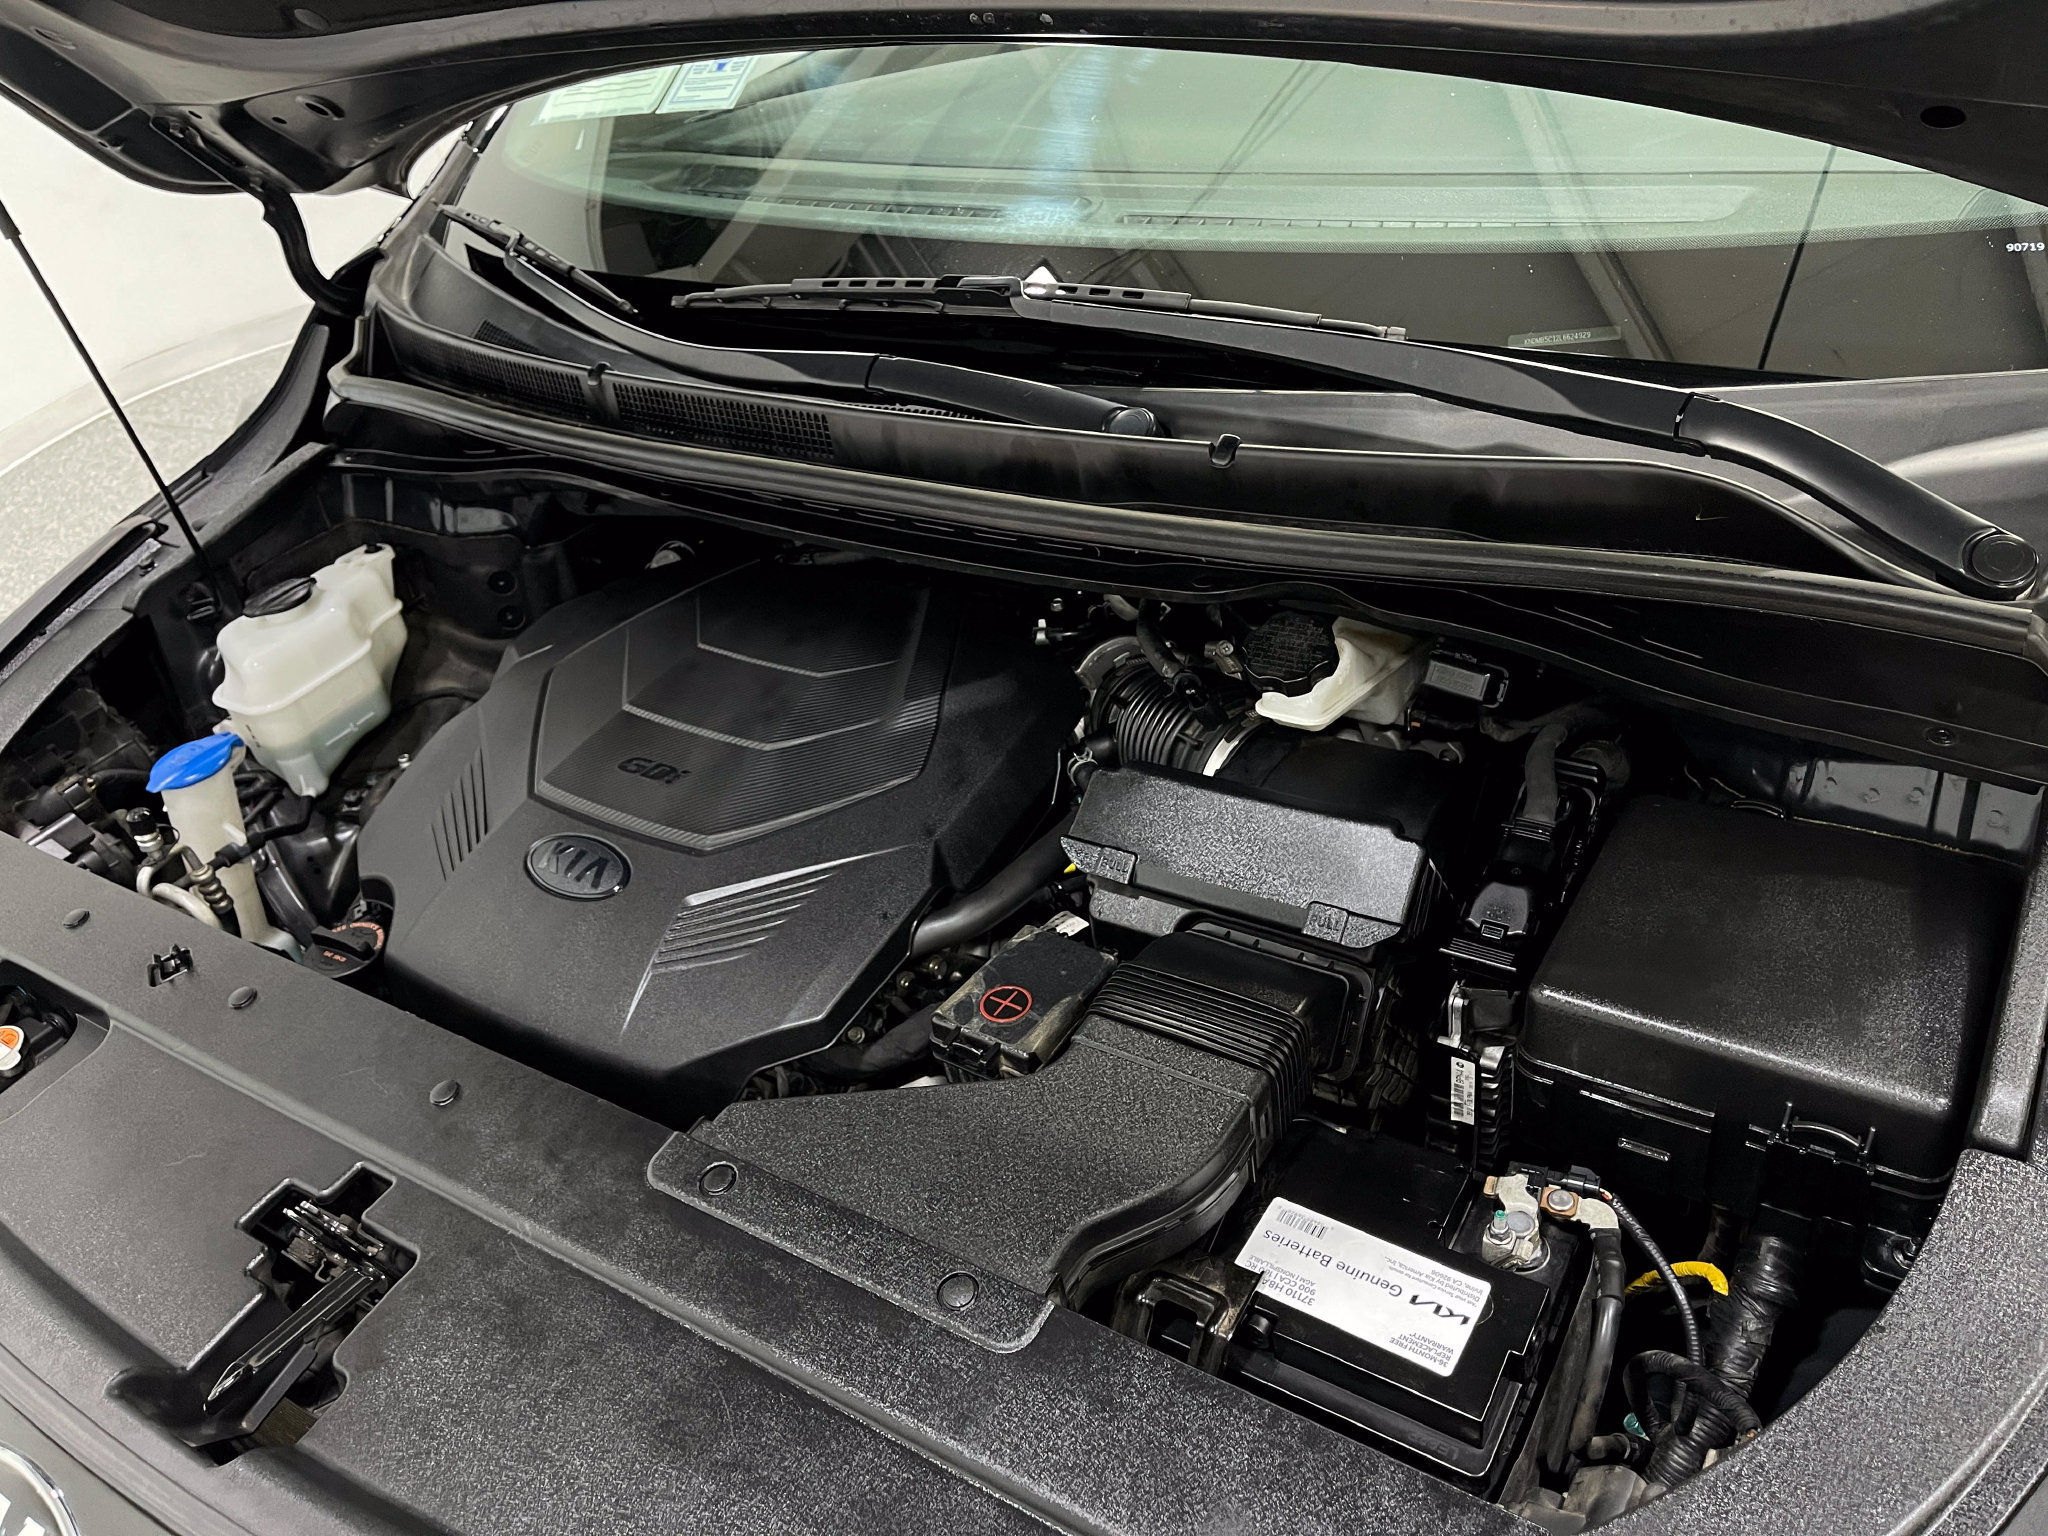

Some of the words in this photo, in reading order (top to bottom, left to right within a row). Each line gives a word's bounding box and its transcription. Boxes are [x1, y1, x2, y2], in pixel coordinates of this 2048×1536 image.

[2006, 242, 2045, 252] 90719
[537, 842, 611, 889] KIA
[1261, 1228, 1333, 1267] Batteries
[1243, 1259, 1258, 1270] RC
[1248, 1254, 1296, 1278] NONSPILLABLE
[1277, 1274, 1298, 1287] CCA
[1298, 1276, 1316, 1286] AGM
[1333, 1259, 1404, 1297] Genuine
[1424, 1273, 1435, 1282] Kia
[1435, 1277, 1445, 1286] by
[1451, 1278, 1463, 1286] CA
[1297, 1283, 1317, 1295] 900
[1444, 1282, 1480, 1301] Distributed
[1284, 1286, 1315, 1306] 37110
[1388, 1336, 1408, 1349] FREE
[1397, 1333, 1451, 1361] REPLACEMENT
[1408, 1344, 1448, 1367] 36-MONTH
